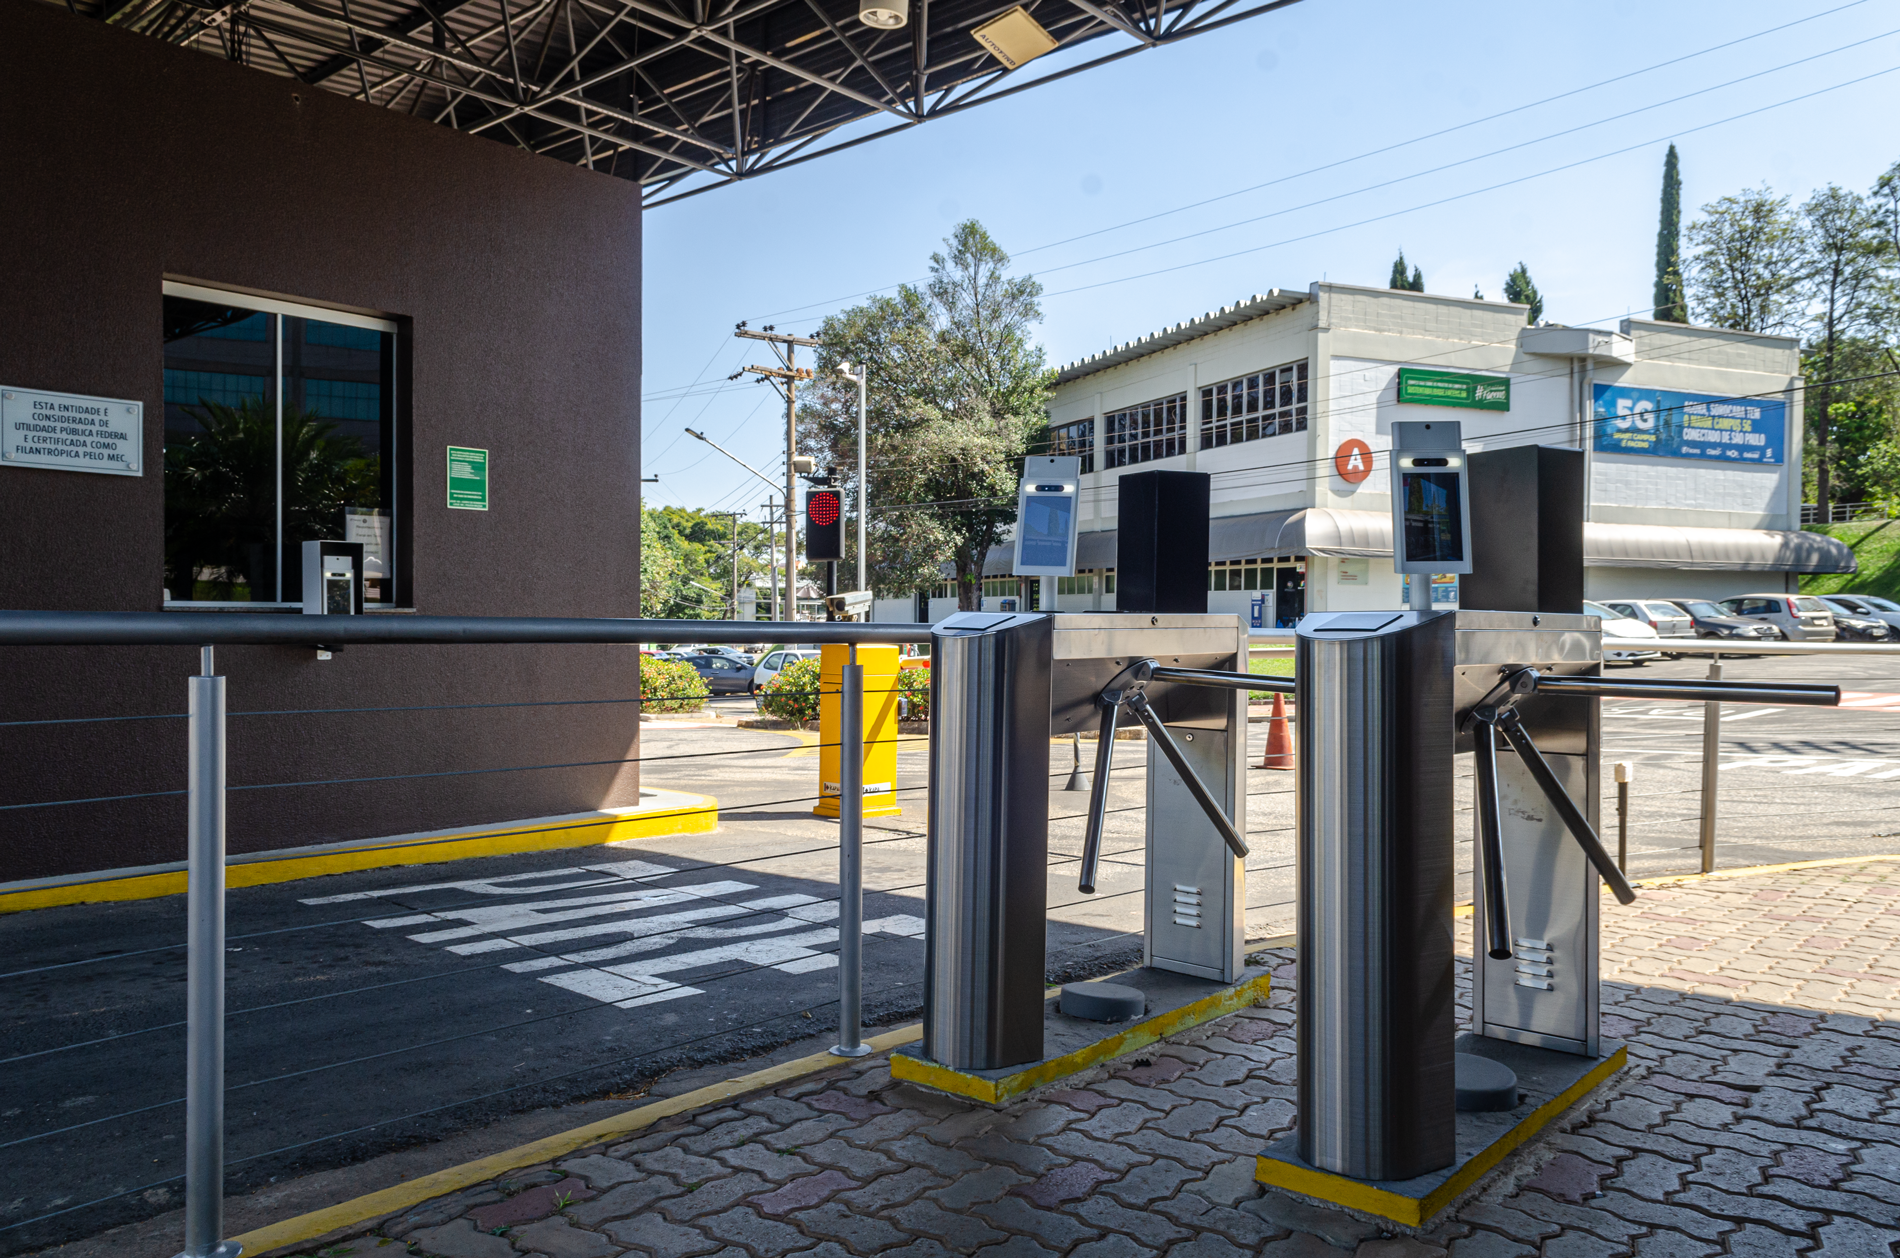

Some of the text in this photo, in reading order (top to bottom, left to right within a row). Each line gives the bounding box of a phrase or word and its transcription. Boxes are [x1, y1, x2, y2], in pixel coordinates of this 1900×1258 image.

[980, 33, 1016, 66] AUTOFIND
[33, 401, 109, 417] ESTA ENTIDADE É
[1615, 398, 1655, 430] 5G
[32, 412, 110, 428] CONSIDERADA DE
[1713, 416, 1742, 431] CAMPUS
[1742, 419, 1752, 431] 5G
[14, 422, 129, 441] UTILIDADE PÚBLICA FEDERAL
[1682, 427, 1766, 446] CONECTADO DE SÃO PAULO
[23, 434, 118, 451] E CERTIFICADA COMO
[16, 445, 128, 463] FILANTRÓPICA PELO MEC.
[1347, 447, 1365, 470] A
